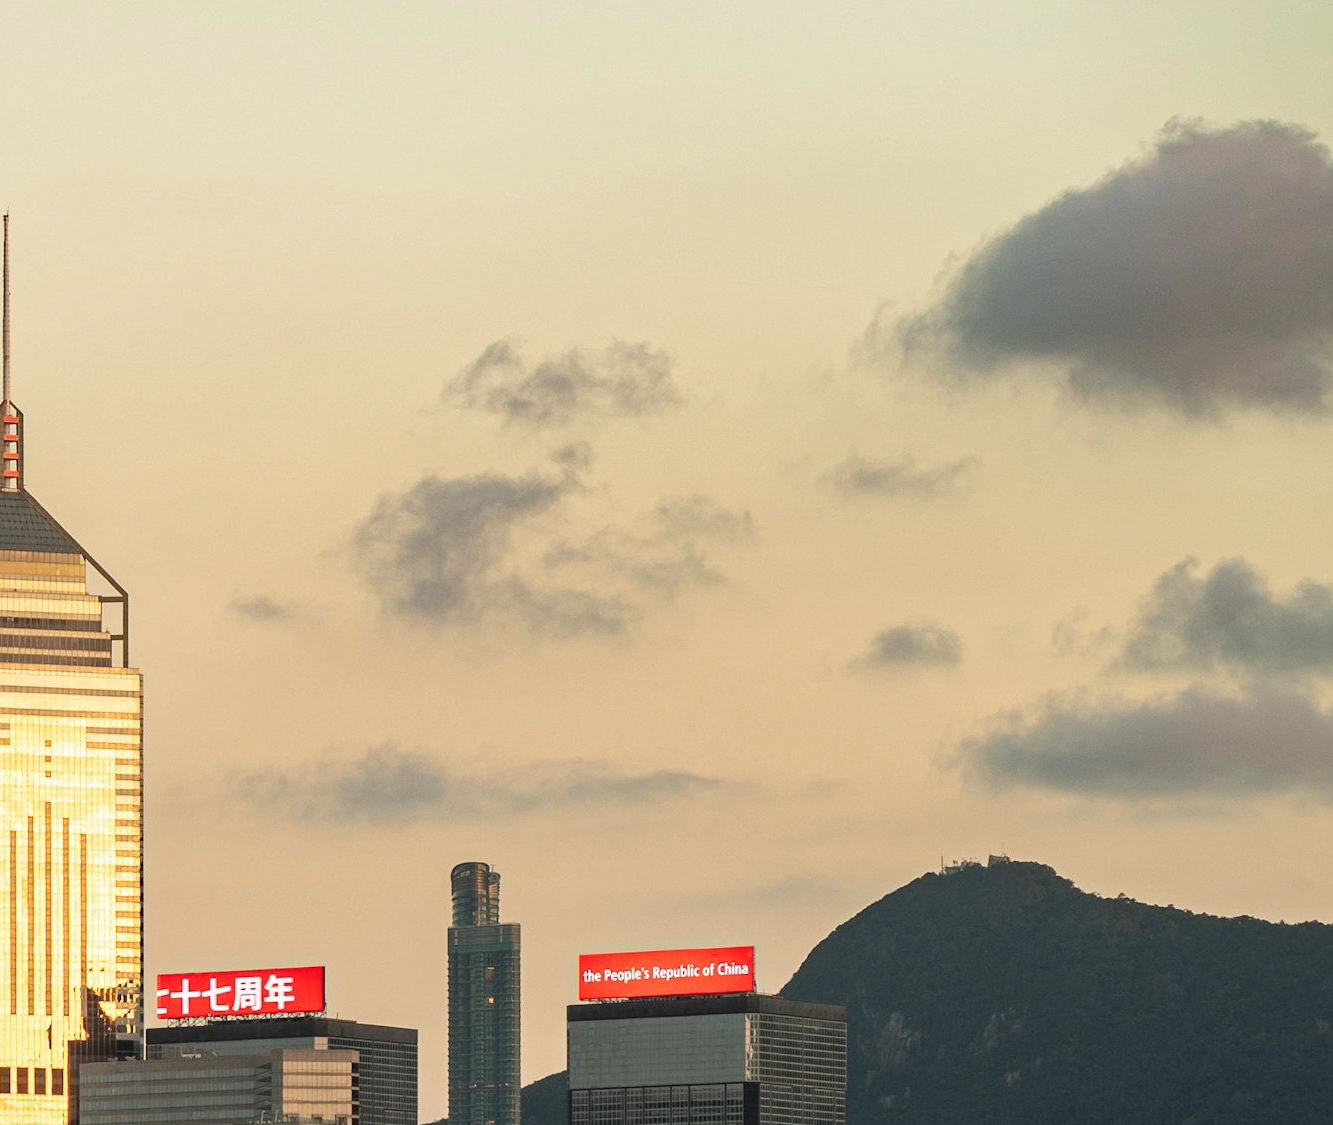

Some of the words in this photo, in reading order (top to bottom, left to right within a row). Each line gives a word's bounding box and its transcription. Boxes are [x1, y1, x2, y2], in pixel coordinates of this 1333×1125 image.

[583, 969, 602, 982] the
[604, 967, 650, 984] People's
[652, 964, 700, 981] Republic
[702, 963, 715, 976] of
[717, 962, 749, 976] China
